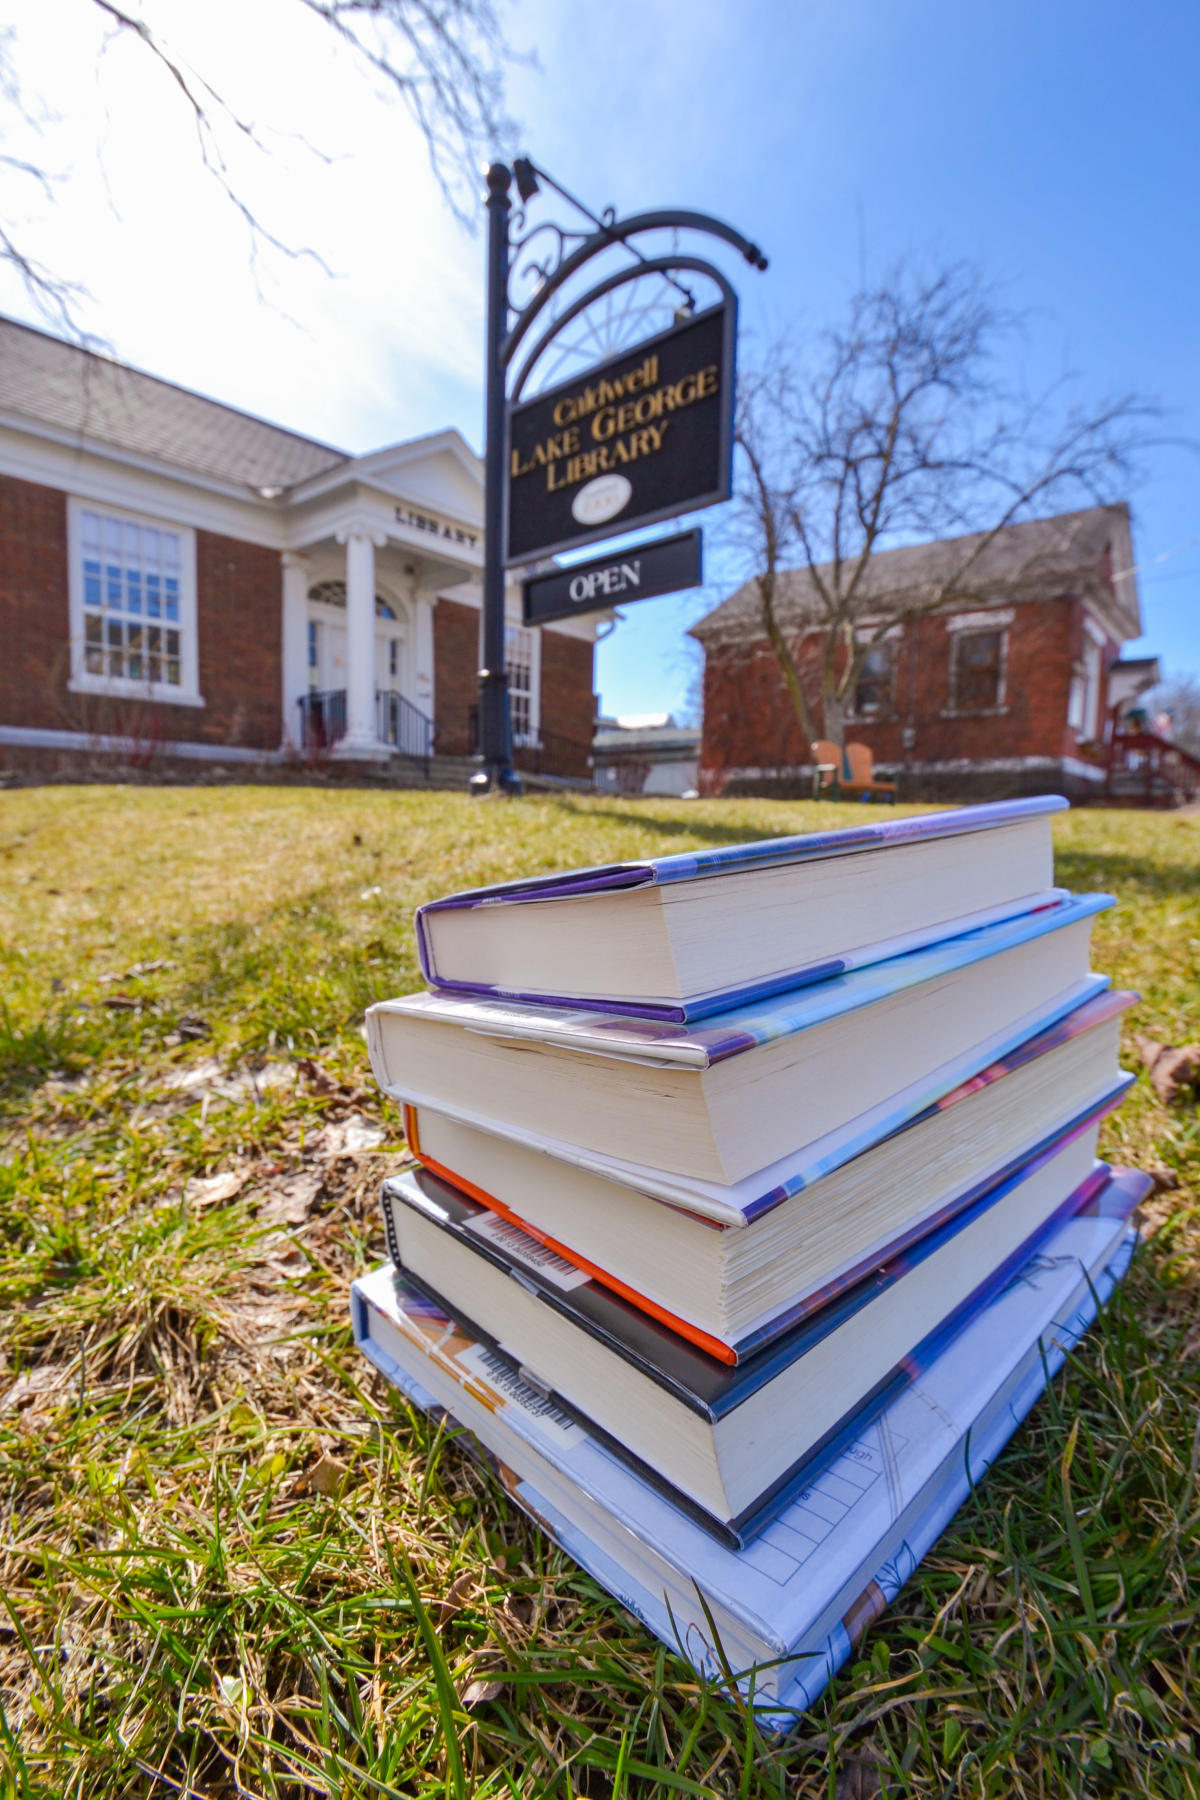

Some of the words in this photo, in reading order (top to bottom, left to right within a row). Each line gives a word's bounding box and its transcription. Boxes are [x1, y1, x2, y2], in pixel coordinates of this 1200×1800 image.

[511, 427, 580, 478] LAKE
[591, 365, 719, 443] GEORGE
[553, 354, 659, 427] Caldwell
[546, 419, 669, 493] LIBRARY
[394, 506, 477, 549] LIBRARY
[569, 560, 641, 602] OPEN
